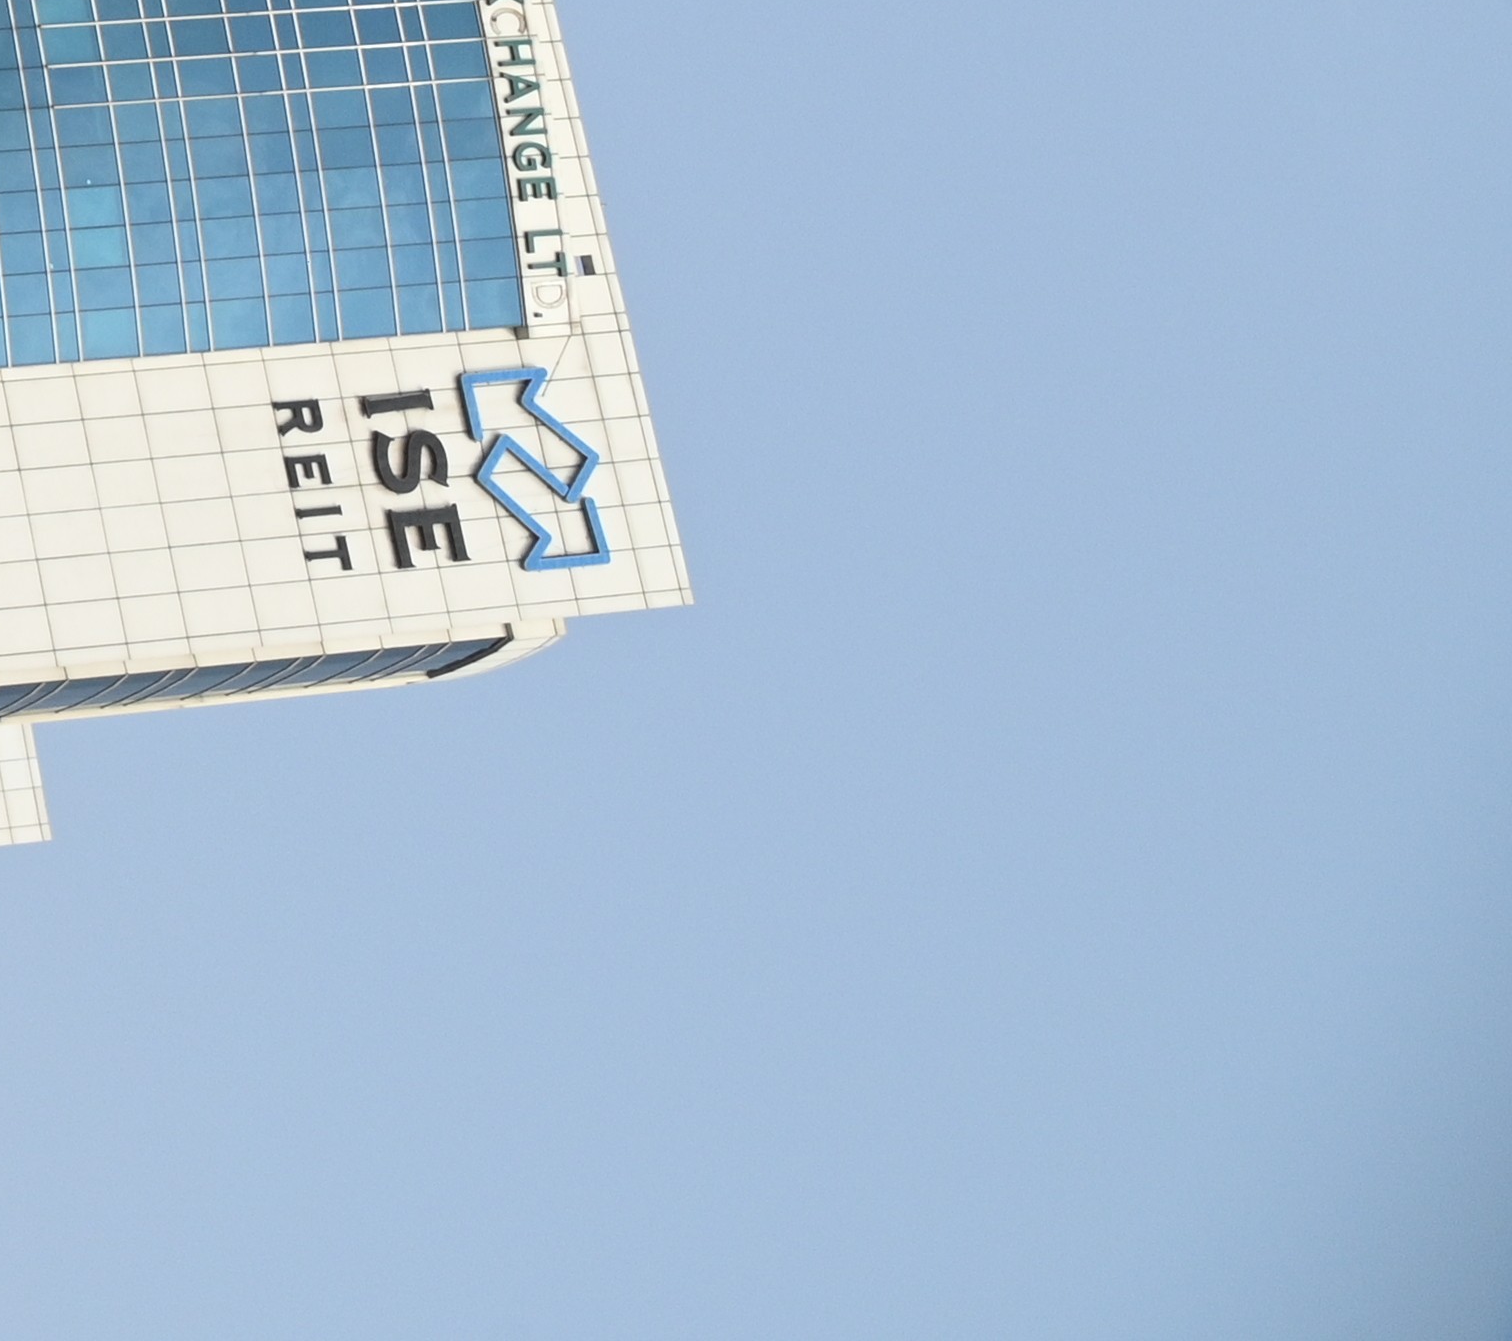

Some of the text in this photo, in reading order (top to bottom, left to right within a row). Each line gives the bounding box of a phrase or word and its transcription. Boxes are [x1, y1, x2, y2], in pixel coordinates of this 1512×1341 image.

[524, 229, 568, 318] LTD.
[271, 398, 353, 571] REIT
[359, 388, 472, 570] ISE
